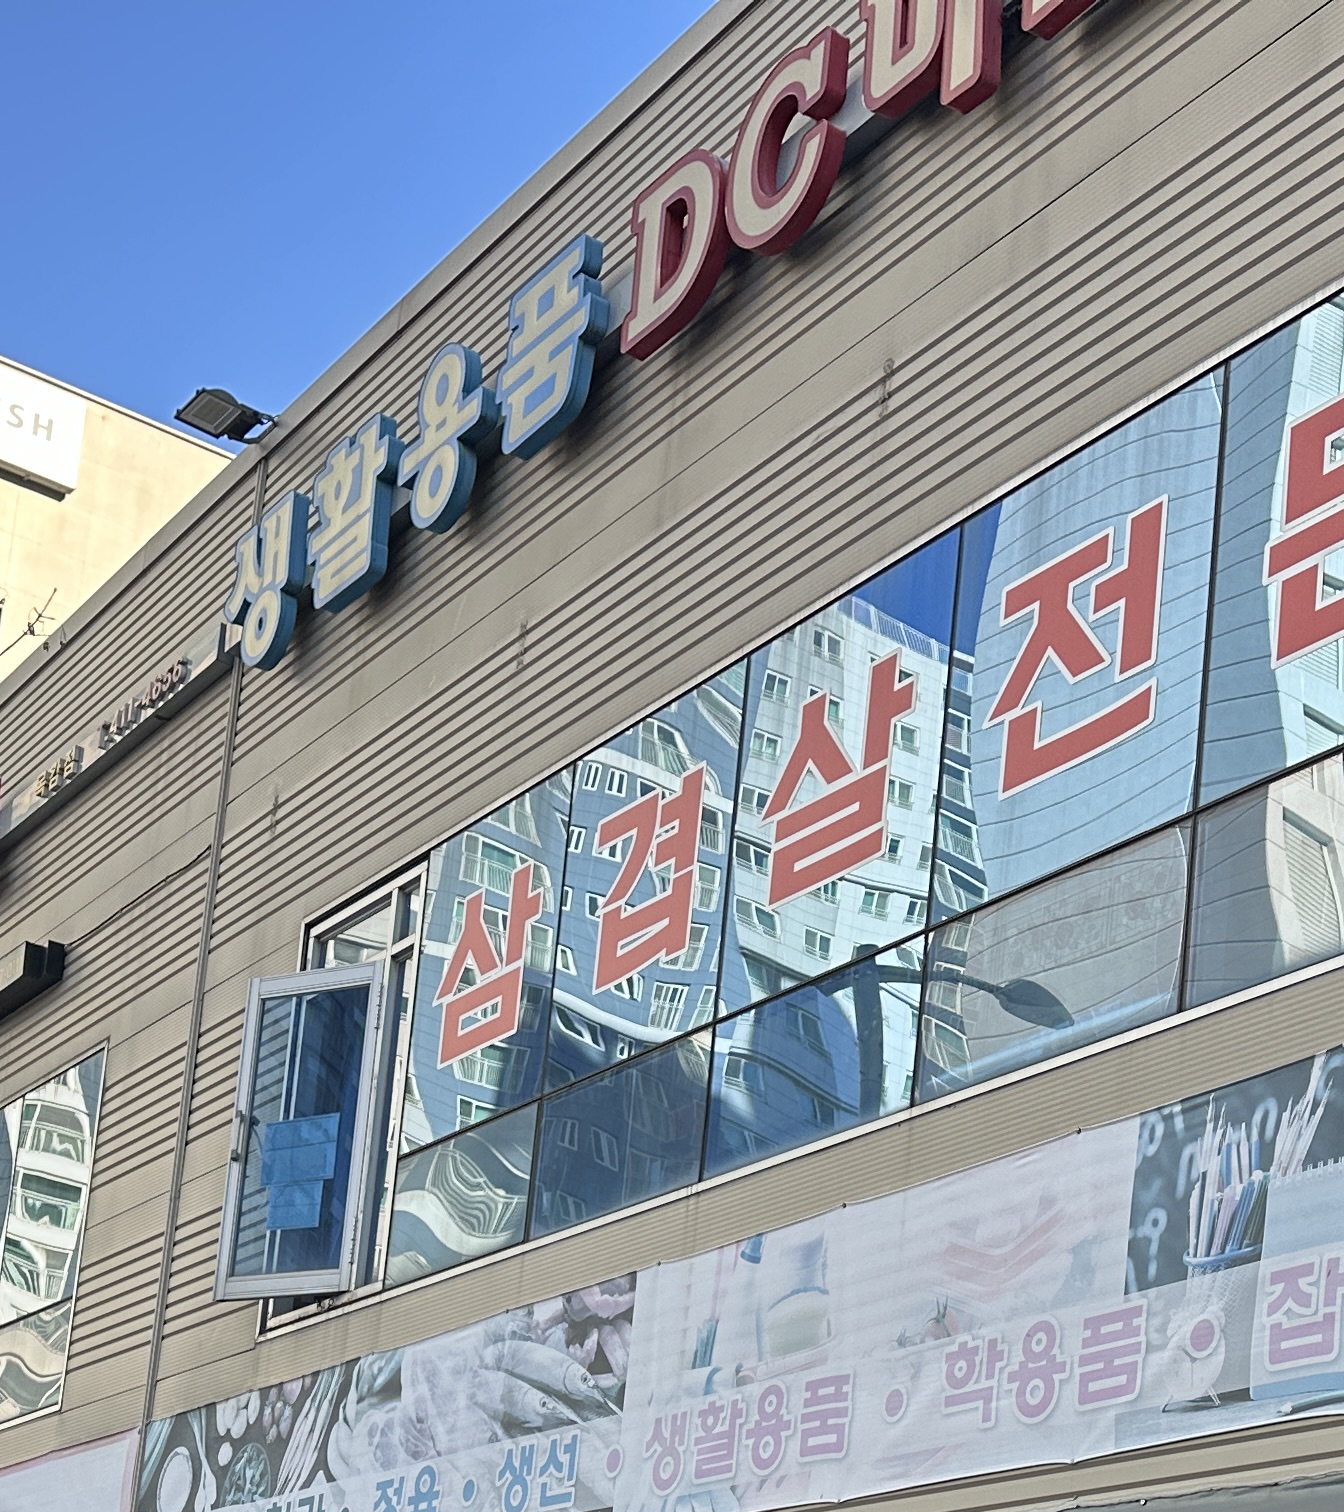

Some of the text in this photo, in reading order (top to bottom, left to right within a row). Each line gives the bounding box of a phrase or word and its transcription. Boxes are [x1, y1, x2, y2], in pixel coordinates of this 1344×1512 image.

[621, 0, 1101, 360] DC마
[224, 233, 611, 671] 생활용품
[435, 648, 918, 1070] 삼겹살
[645, 1370, 854, 1496] 생활용품
[942, 1302, 1148, 1429] 학용품
